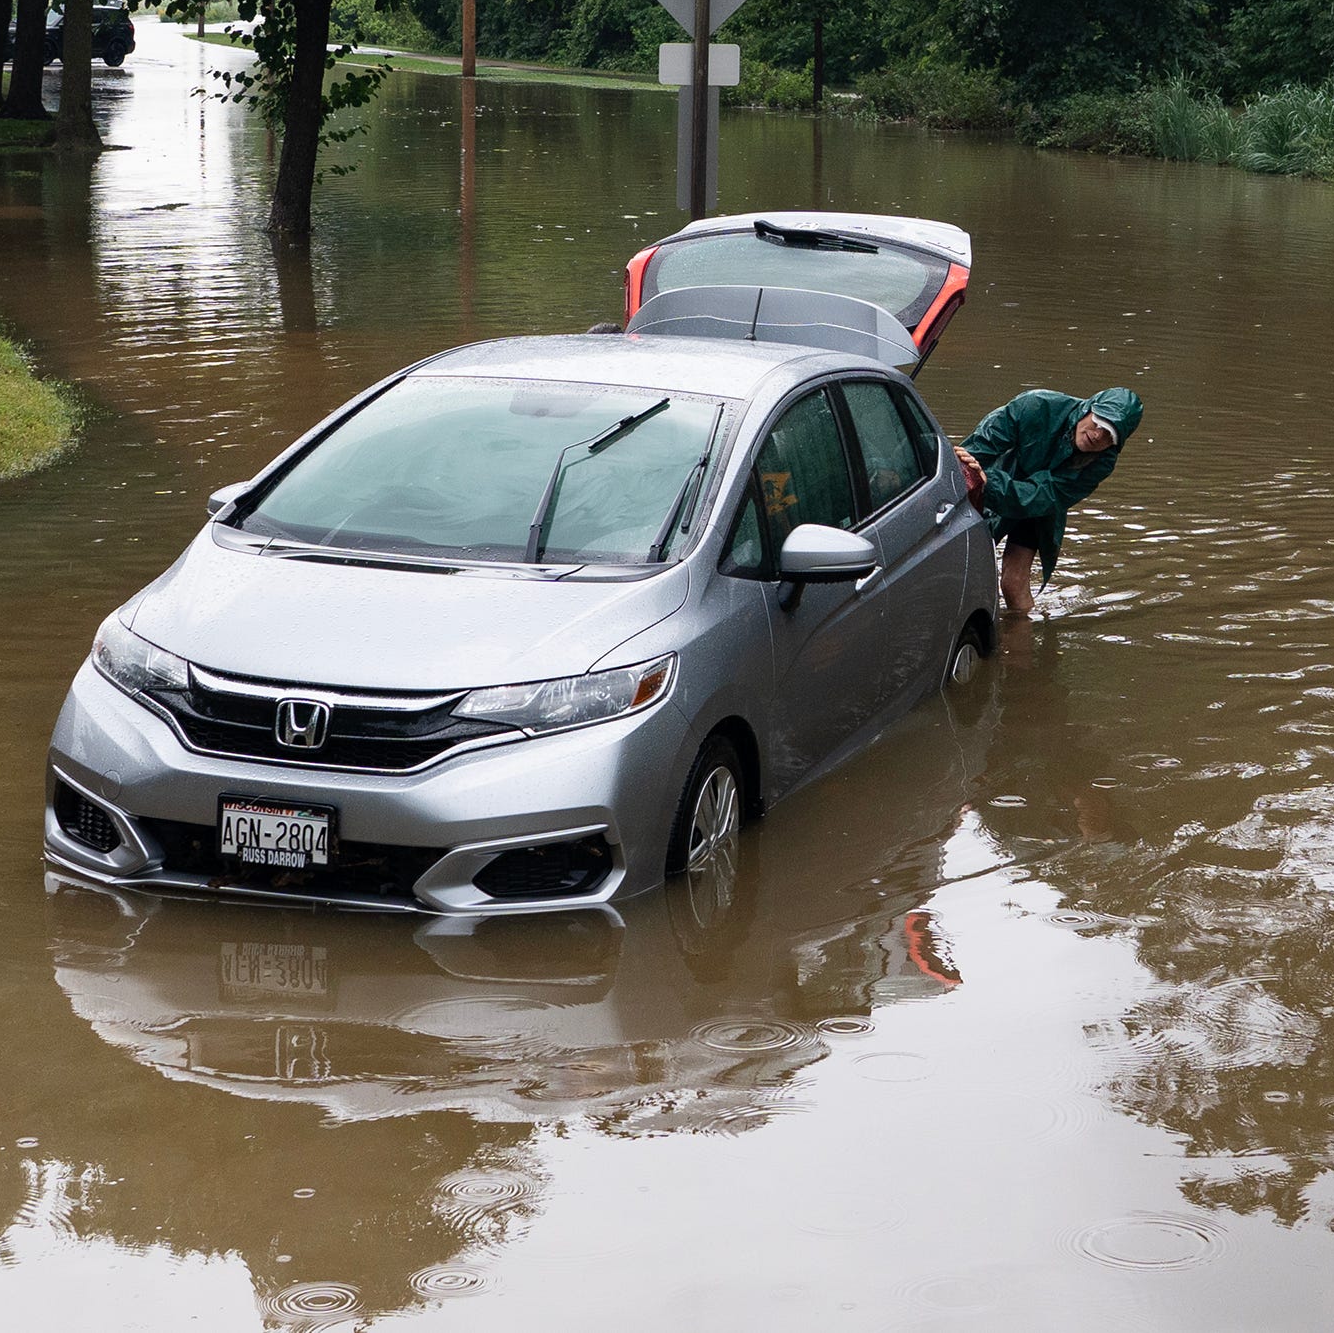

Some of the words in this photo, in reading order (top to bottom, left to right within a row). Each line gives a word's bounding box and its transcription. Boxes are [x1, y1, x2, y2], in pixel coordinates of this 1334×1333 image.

[223, 816, 327, 856] AGN-2804
[242, 847, 266, 864] RUSS
[267, 850, 306, 869] DARROW
